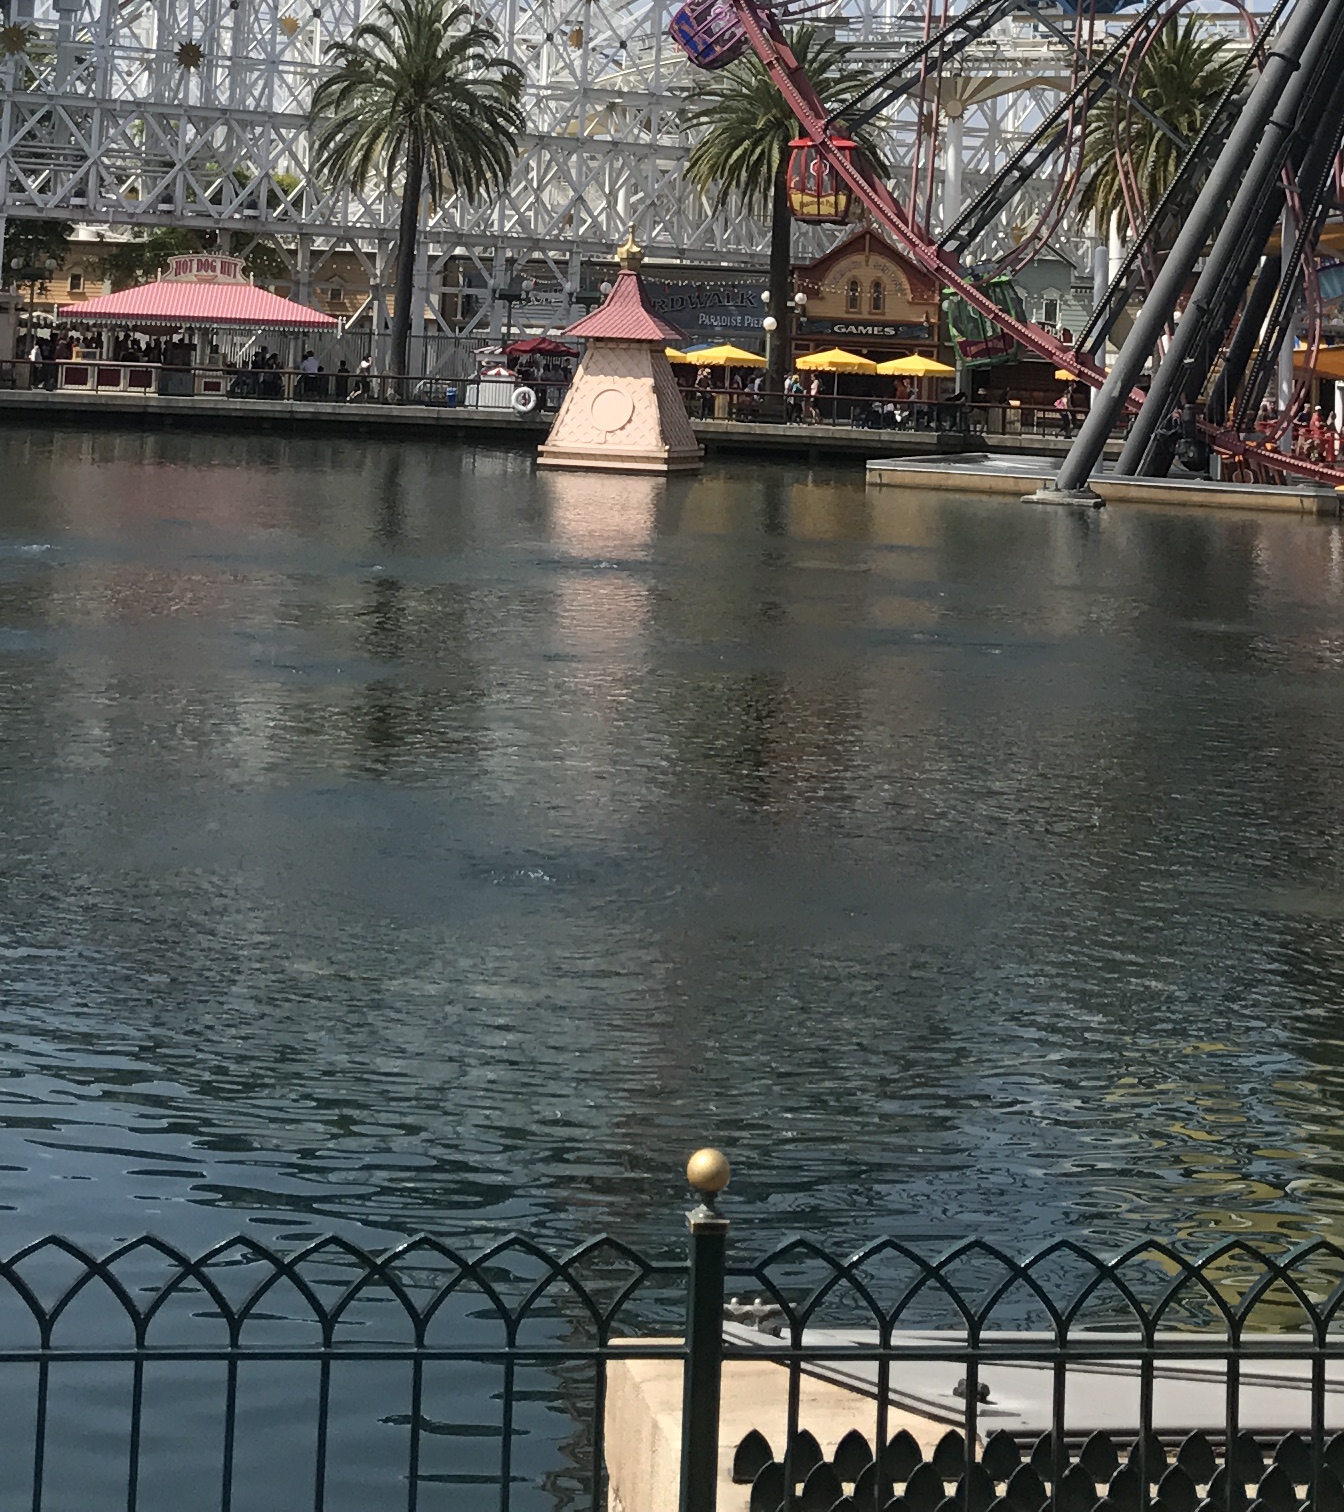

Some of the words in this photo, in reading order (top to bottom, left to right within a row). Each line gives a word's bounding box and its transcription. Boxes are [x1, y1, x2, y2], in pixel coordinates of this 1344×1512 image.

[174, 259, 194, 277] HOT
[196, 258, 217, 273] DOG
[220, 260, 238, 279] HUT
[698, 312, 742, 326] PARADISE
[833, 324, 896, 336] GAMES
